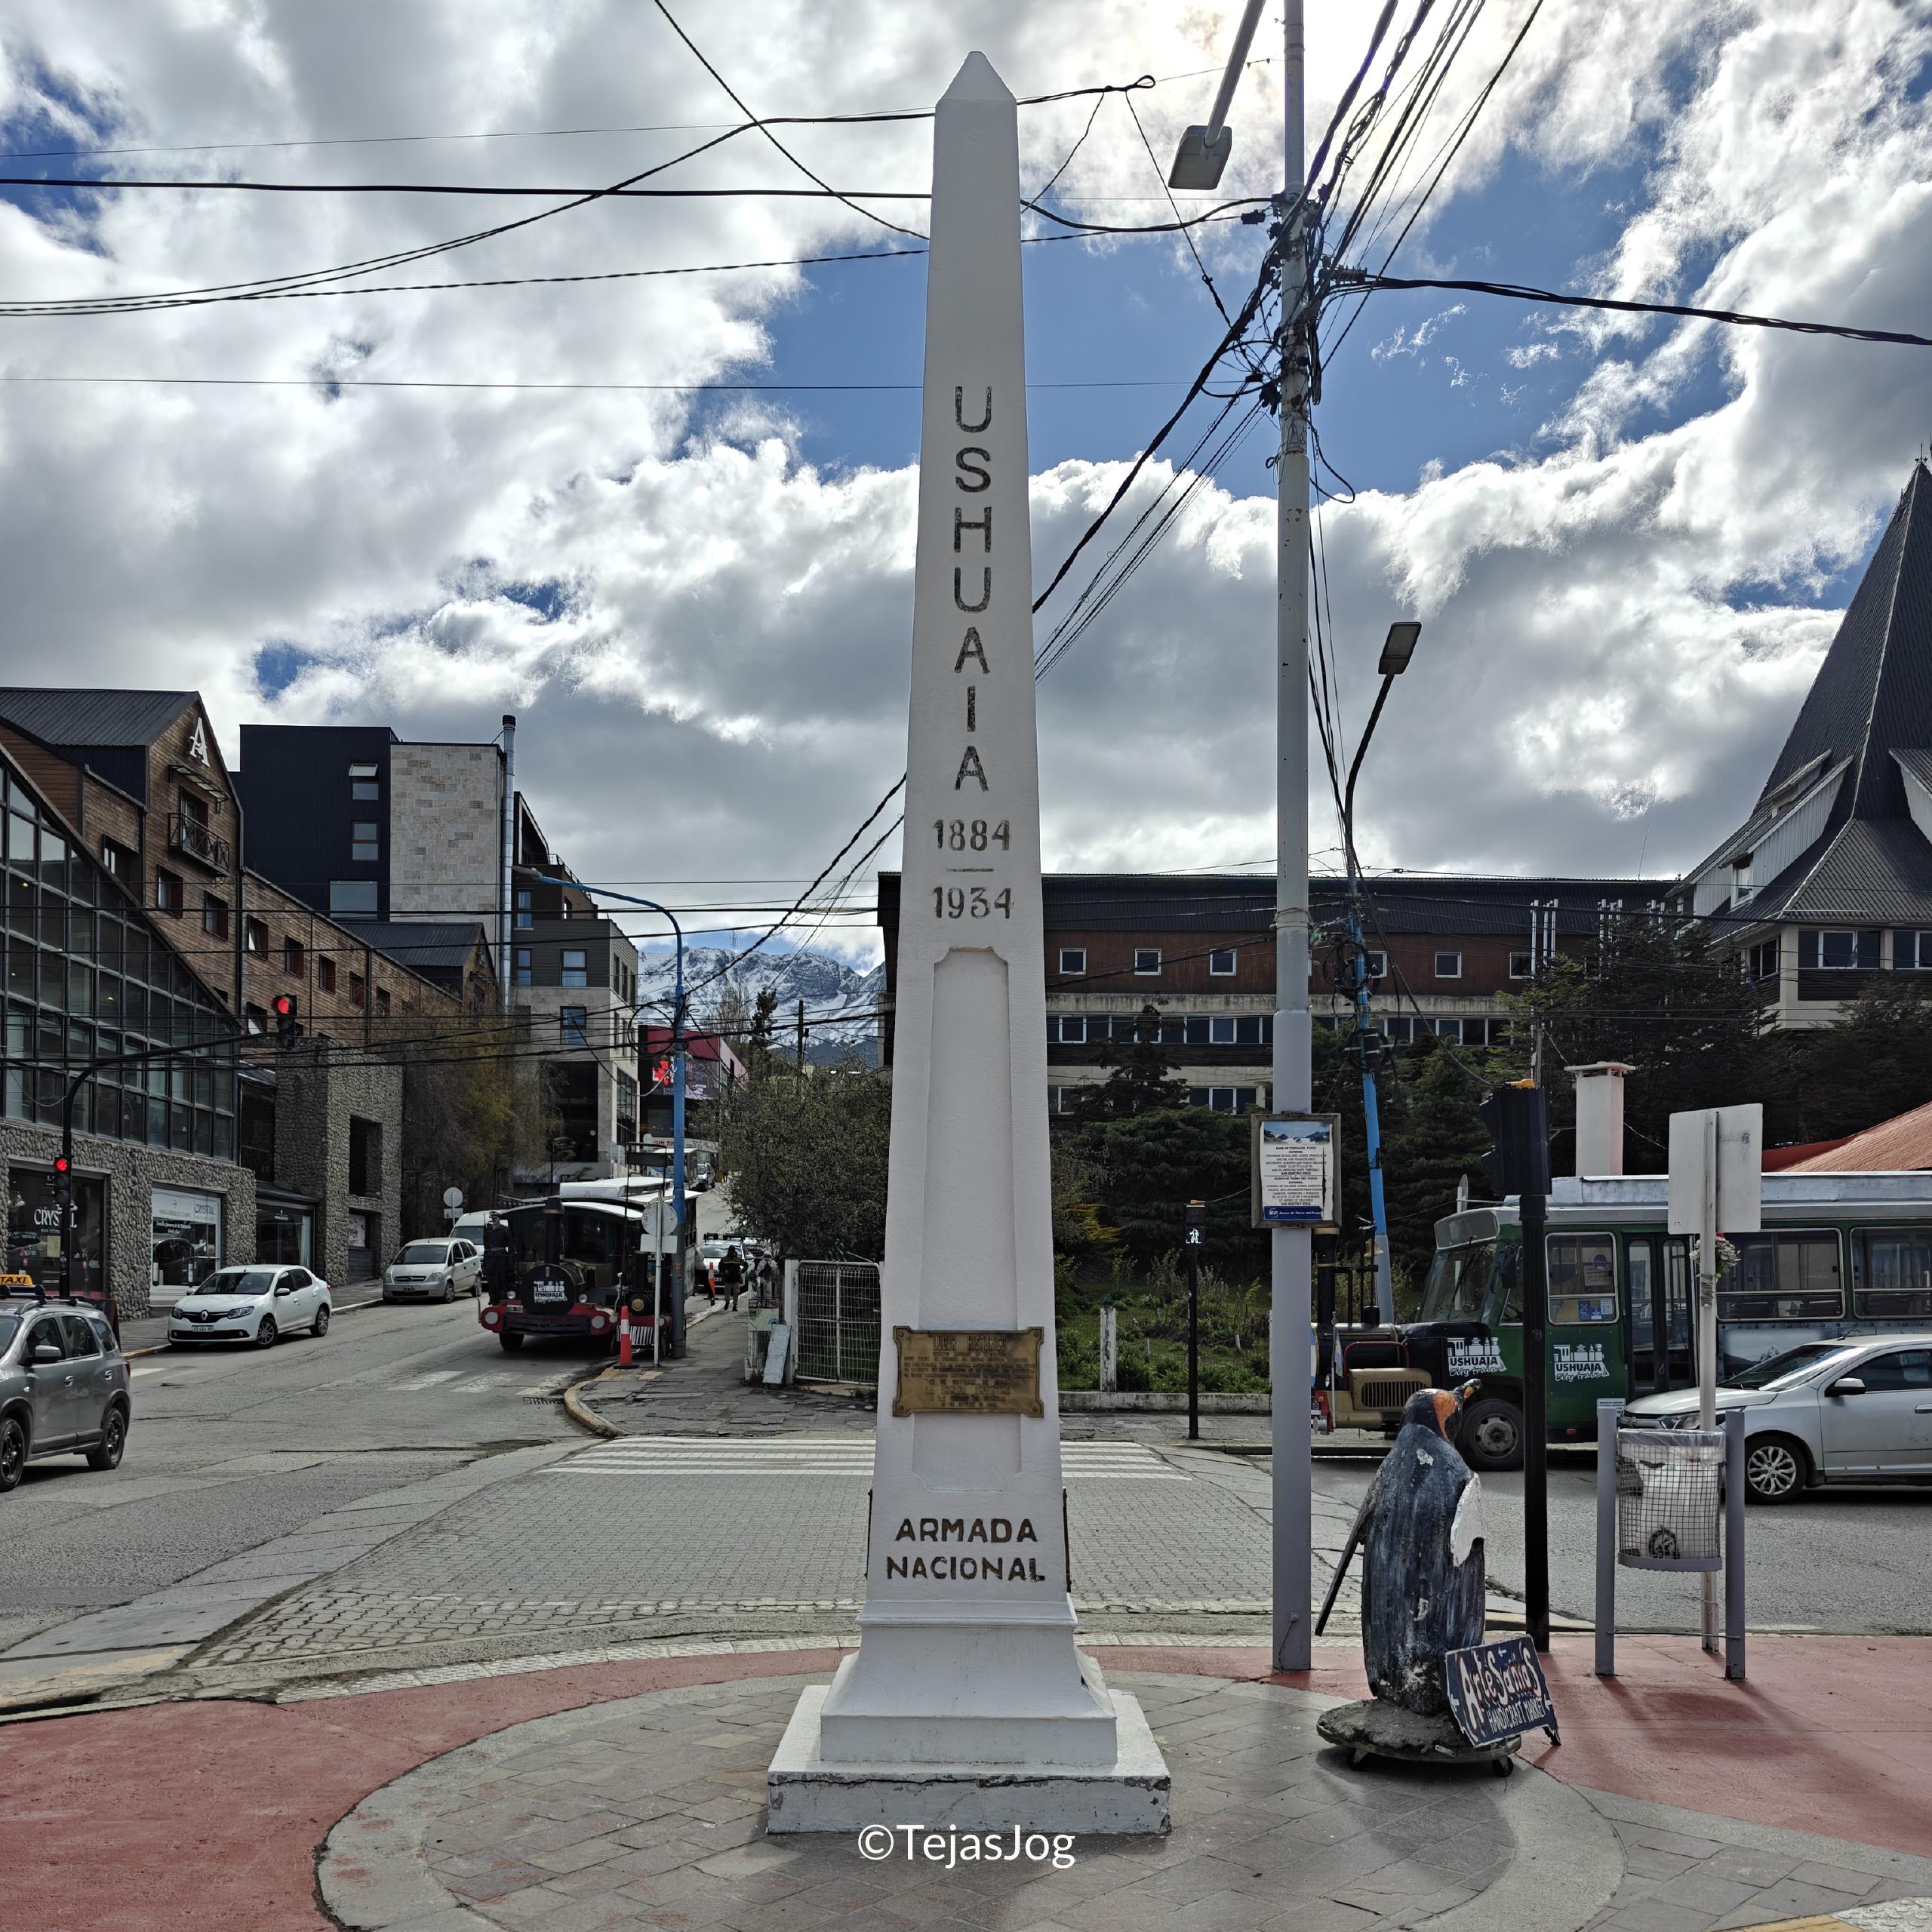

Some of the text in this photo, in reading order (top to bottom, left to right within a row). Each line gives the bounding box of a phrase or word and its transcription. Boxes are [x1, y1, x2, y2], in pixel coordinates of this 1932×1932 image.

[953, 386, 992, 792] USHUAIA
[933, 819, 1011, 851] 1884
[933, 886, 1012, 919] 1934
[34, 1208, 78, 1228] CRYSL
[933, 1335, 957, 1351] LUGAR
[1449, 1365, 1500, 1377] City train
[1450, 1357, 1498, 1366] USHUAIA
[1555, 1363, 1601, 1371] USHUAIA
[1555, 1371, 1604, 1382] City train
[895, 1518, 1038, 1543] ARMADA
[886, 1556, 1046, 1582] NACIONAL
[1487, 1697, 1546, 1734] HANDICRAFT MARKET
